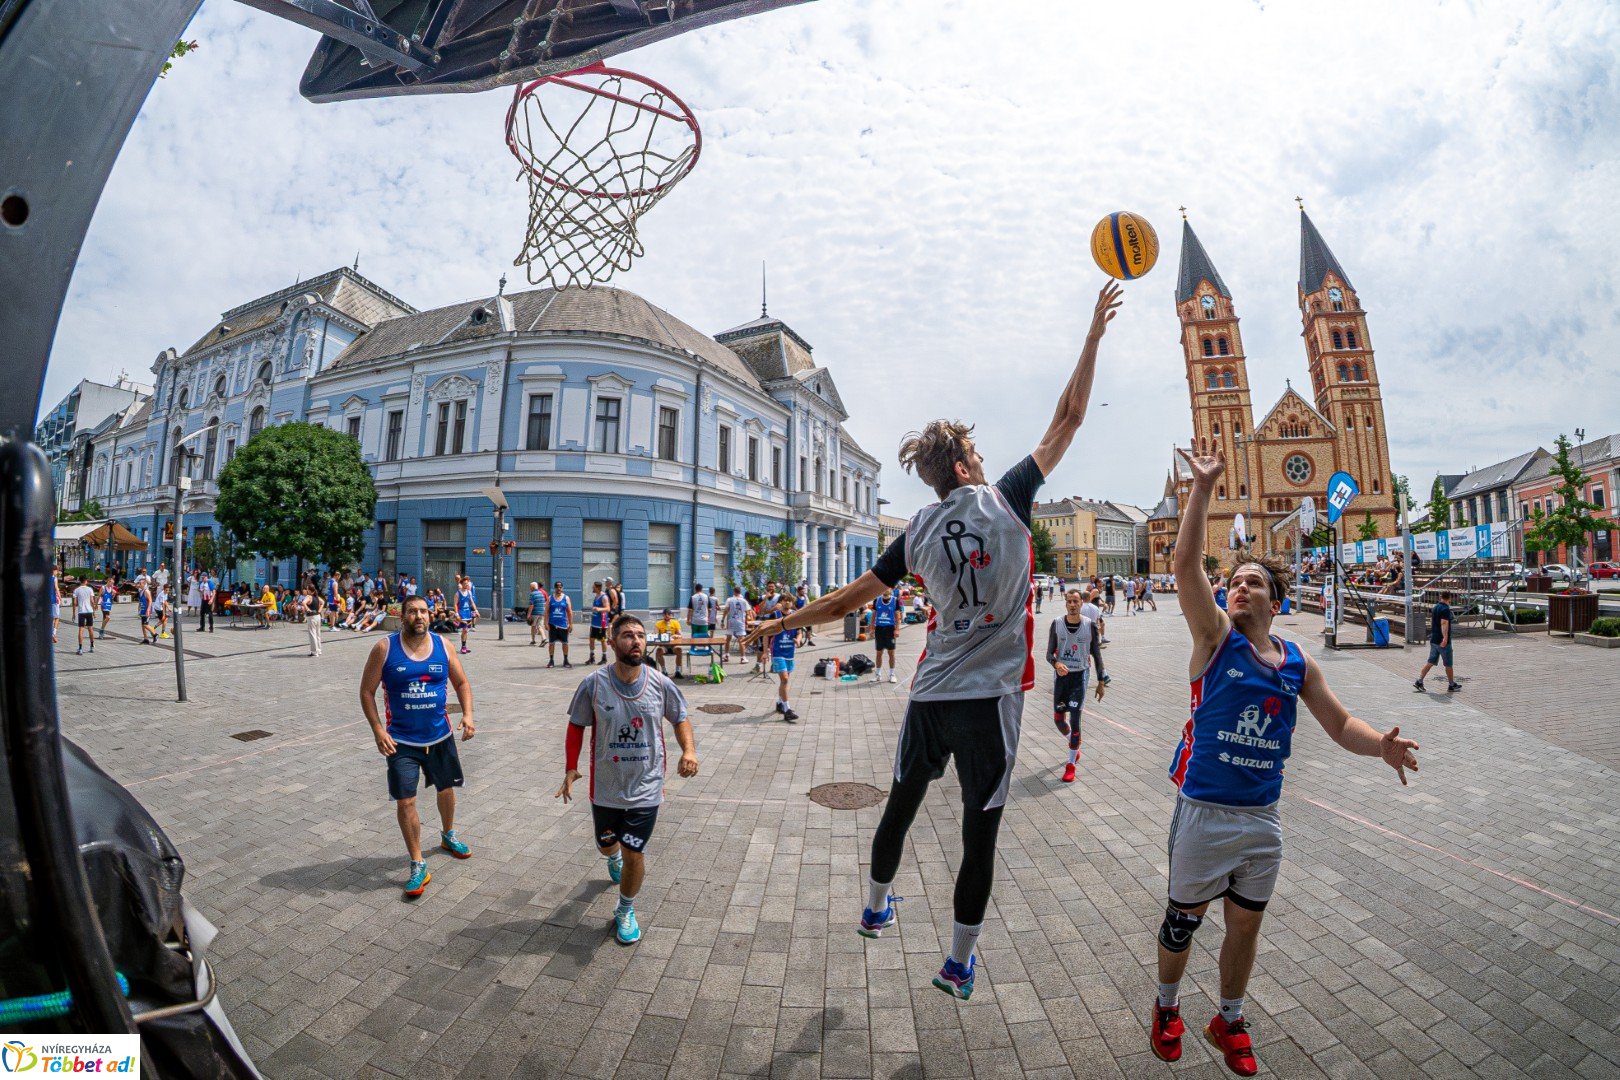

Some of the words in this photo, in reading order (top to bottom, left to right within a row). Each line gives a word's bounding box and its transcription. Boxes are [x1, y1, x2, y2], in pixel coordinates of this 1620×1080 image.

[1125, 224, 1141, 265] molten
[401, 691, 438, 699] STREETBALL
[1216, 730, 1280, 750] STREETBALL
[1231, 756, 1274, 769] SUZUKI
